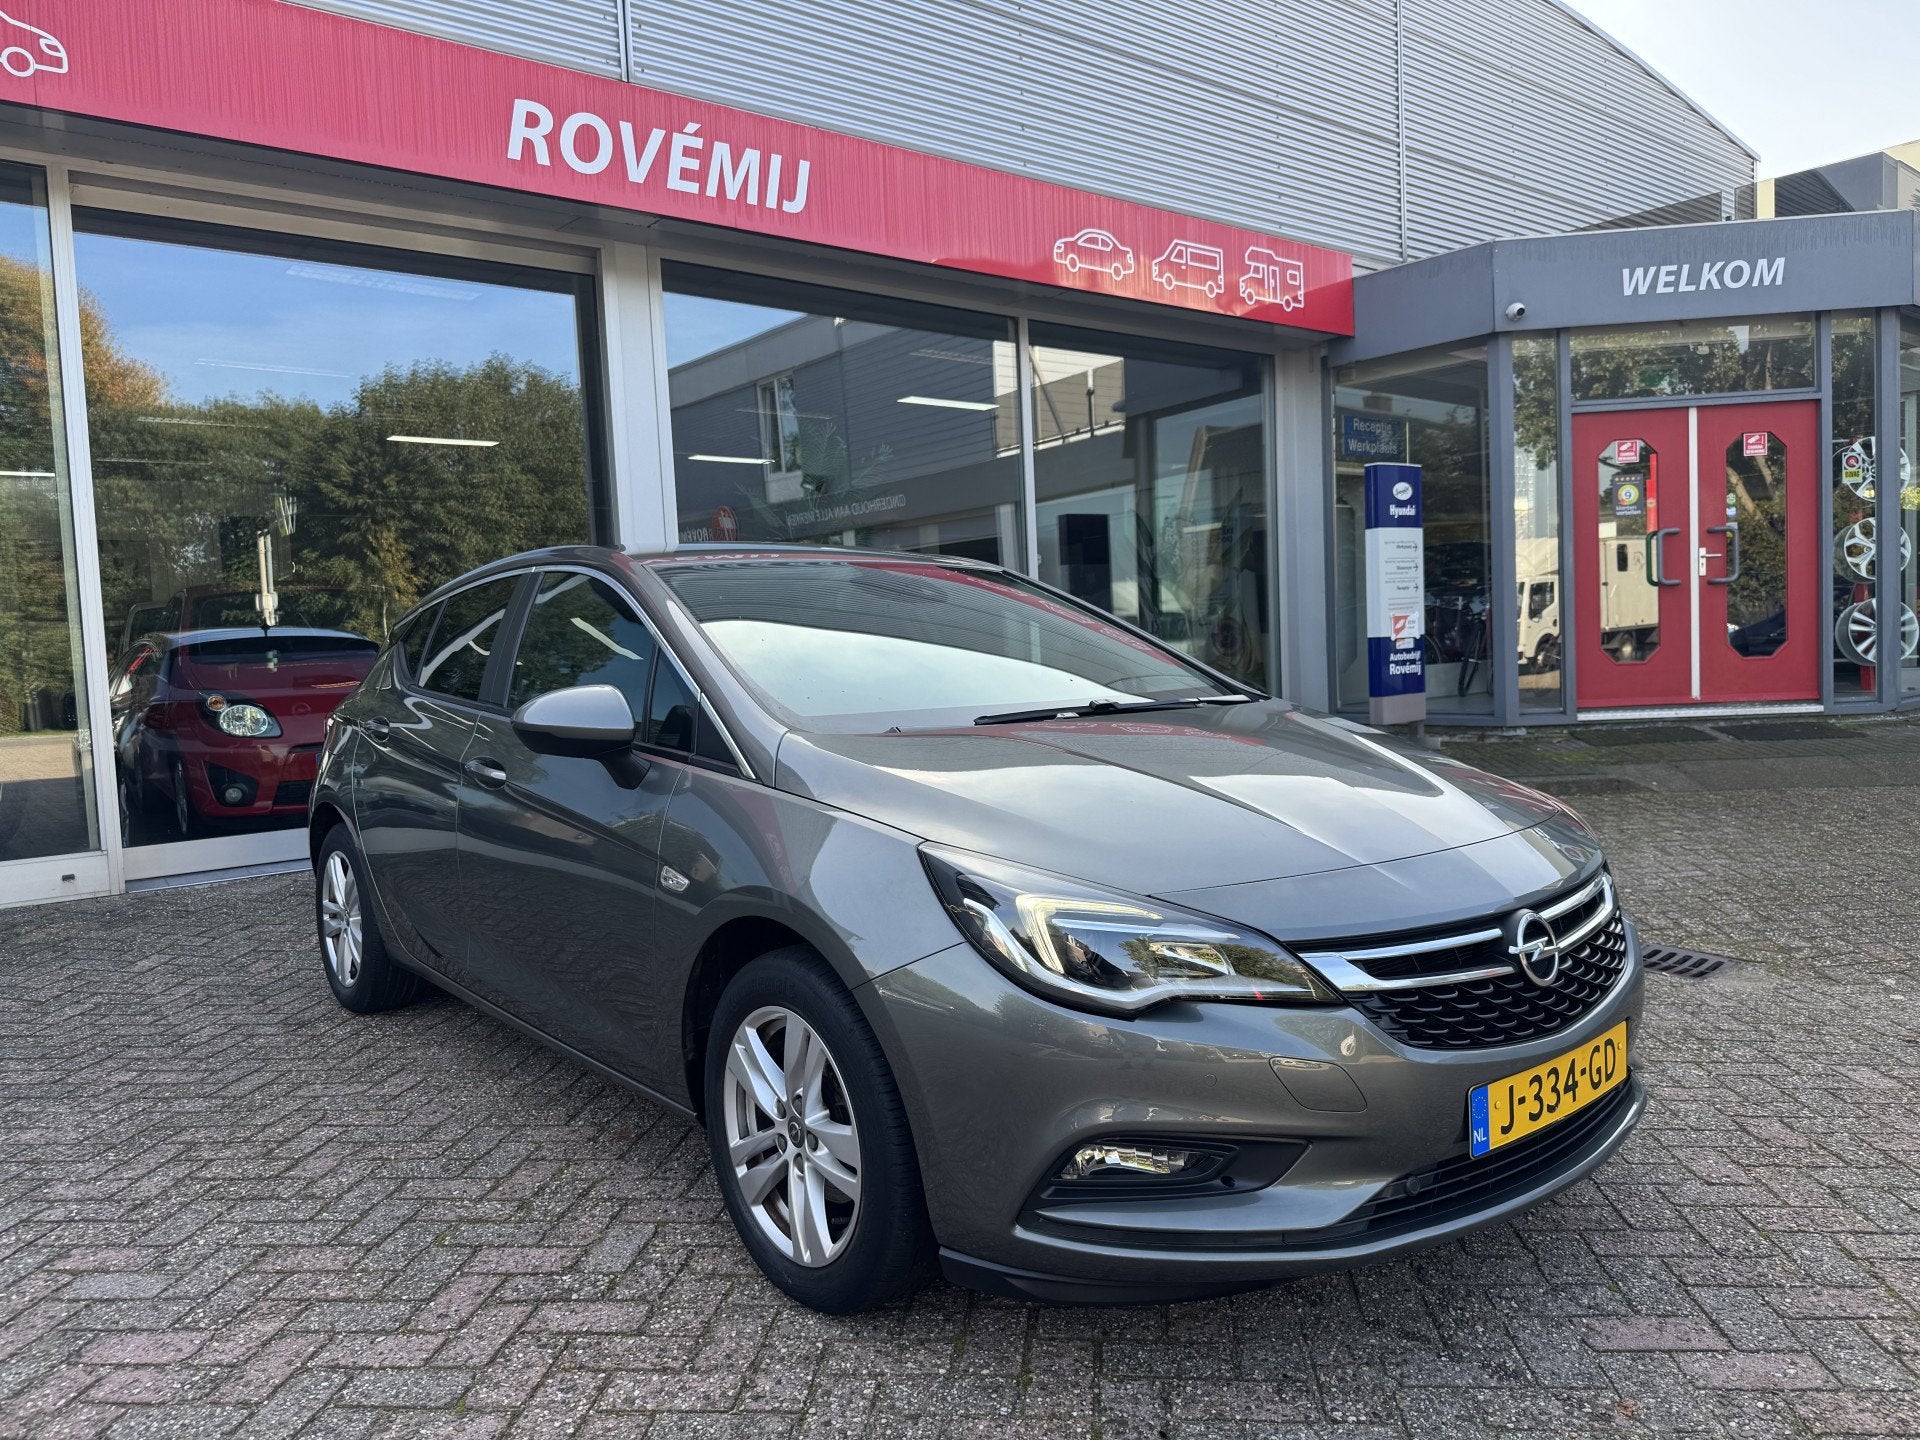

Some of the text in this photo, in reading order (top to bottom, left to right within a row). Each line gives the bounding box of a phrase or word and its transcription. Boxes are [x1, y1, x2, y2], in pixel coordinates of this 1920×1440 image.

[507, 98, 811, 214] ROVÉMIJ
[1622, 257, 1786, 296] WELKOM
[1353, 418, 1392, 434] Receptie
[1348, 438, 1398, 455] Werkplaats
[1624, 490, 1632, 500] 9
[1389, 504, 1416, 518] Hyundai
[1389, 650, 1421, 661] Autobedrijf
[1389, 661, 1422, 675] Rovémij
[1500, 1037, 1616, 1135] J-334-GD
[1473, 1127, 1487, 1145] NL
